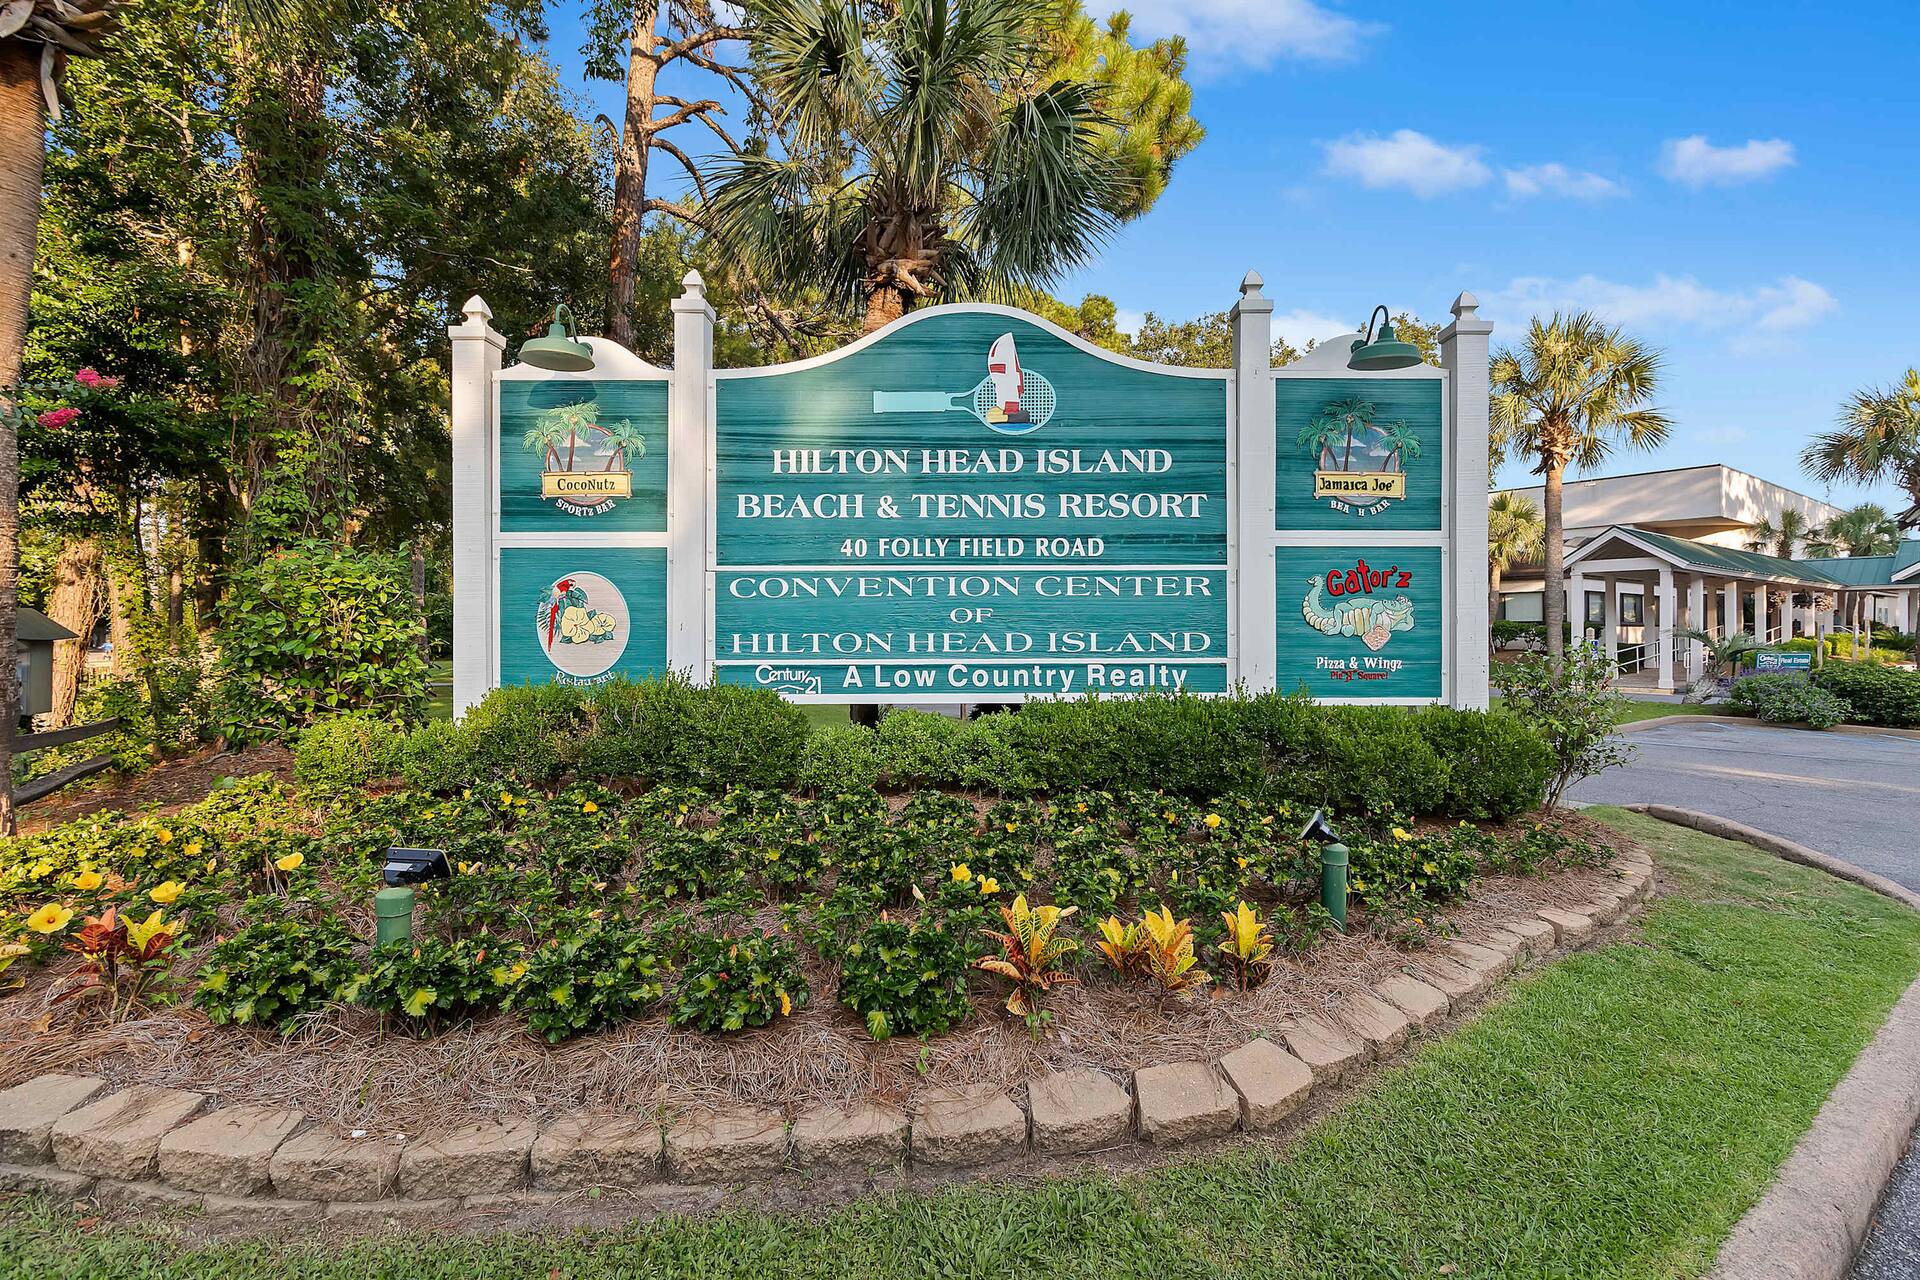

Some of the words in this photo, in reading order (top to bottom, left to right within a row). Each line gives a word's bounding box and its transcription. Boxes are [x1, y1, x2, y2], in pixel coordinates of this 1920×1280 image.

[772, 449, 910, 474] HILTON
[921, 449, 1024, 474] HEAD
[1035, 449, 1173, 474] ISLAND
[557, 478, 616, 491] CocoNutz
[1319, 478, 1368, 491] Jamaica
[556, 499, 594, 516] SPORTZ
[596, 499, 617, 515] BAR
[736, 493, 865, 518] BEACH
[876, 495, 901, 518] &
[911, 493, 1046, 518] TENNIS
[1058, 492, 1208, 518] RESORT
[1331, 500, 1365, 516] BEAH
[1370, 500, 1391, 516] BAR
[840, 537, 867, 557] 40
[879, 537, 949, 557] FOLLY
[960, 537, 1025, 557] FIELD
[1035, 537, 1105, 557] ROAD
[729, 576, 1020, 598] CONVENTION
[1034, 576, 1212, 597] CENTER
[1327, 560, 1412, 596] Gator'z
[949, 607, 994, 624] OF
[731, 632, 894, 654] HILTON
[907, 631, 1034, 653] HEAD
[1047, 631, 1212, 653] ISLAND
[1316, 656, 1345, 669] Pizza
[1349, 656, 1358, 669] &
[1363, 656, 1403, 672] Wingz
[755, 664, 810, 684] Century
[804, 675, 822, 694] 21
[843, 665, 864, 687] A
[875, 665, 936, 687] Low
[948, 664, 1075, 692] Country
[1087, 664, 1187, 692] Realty
